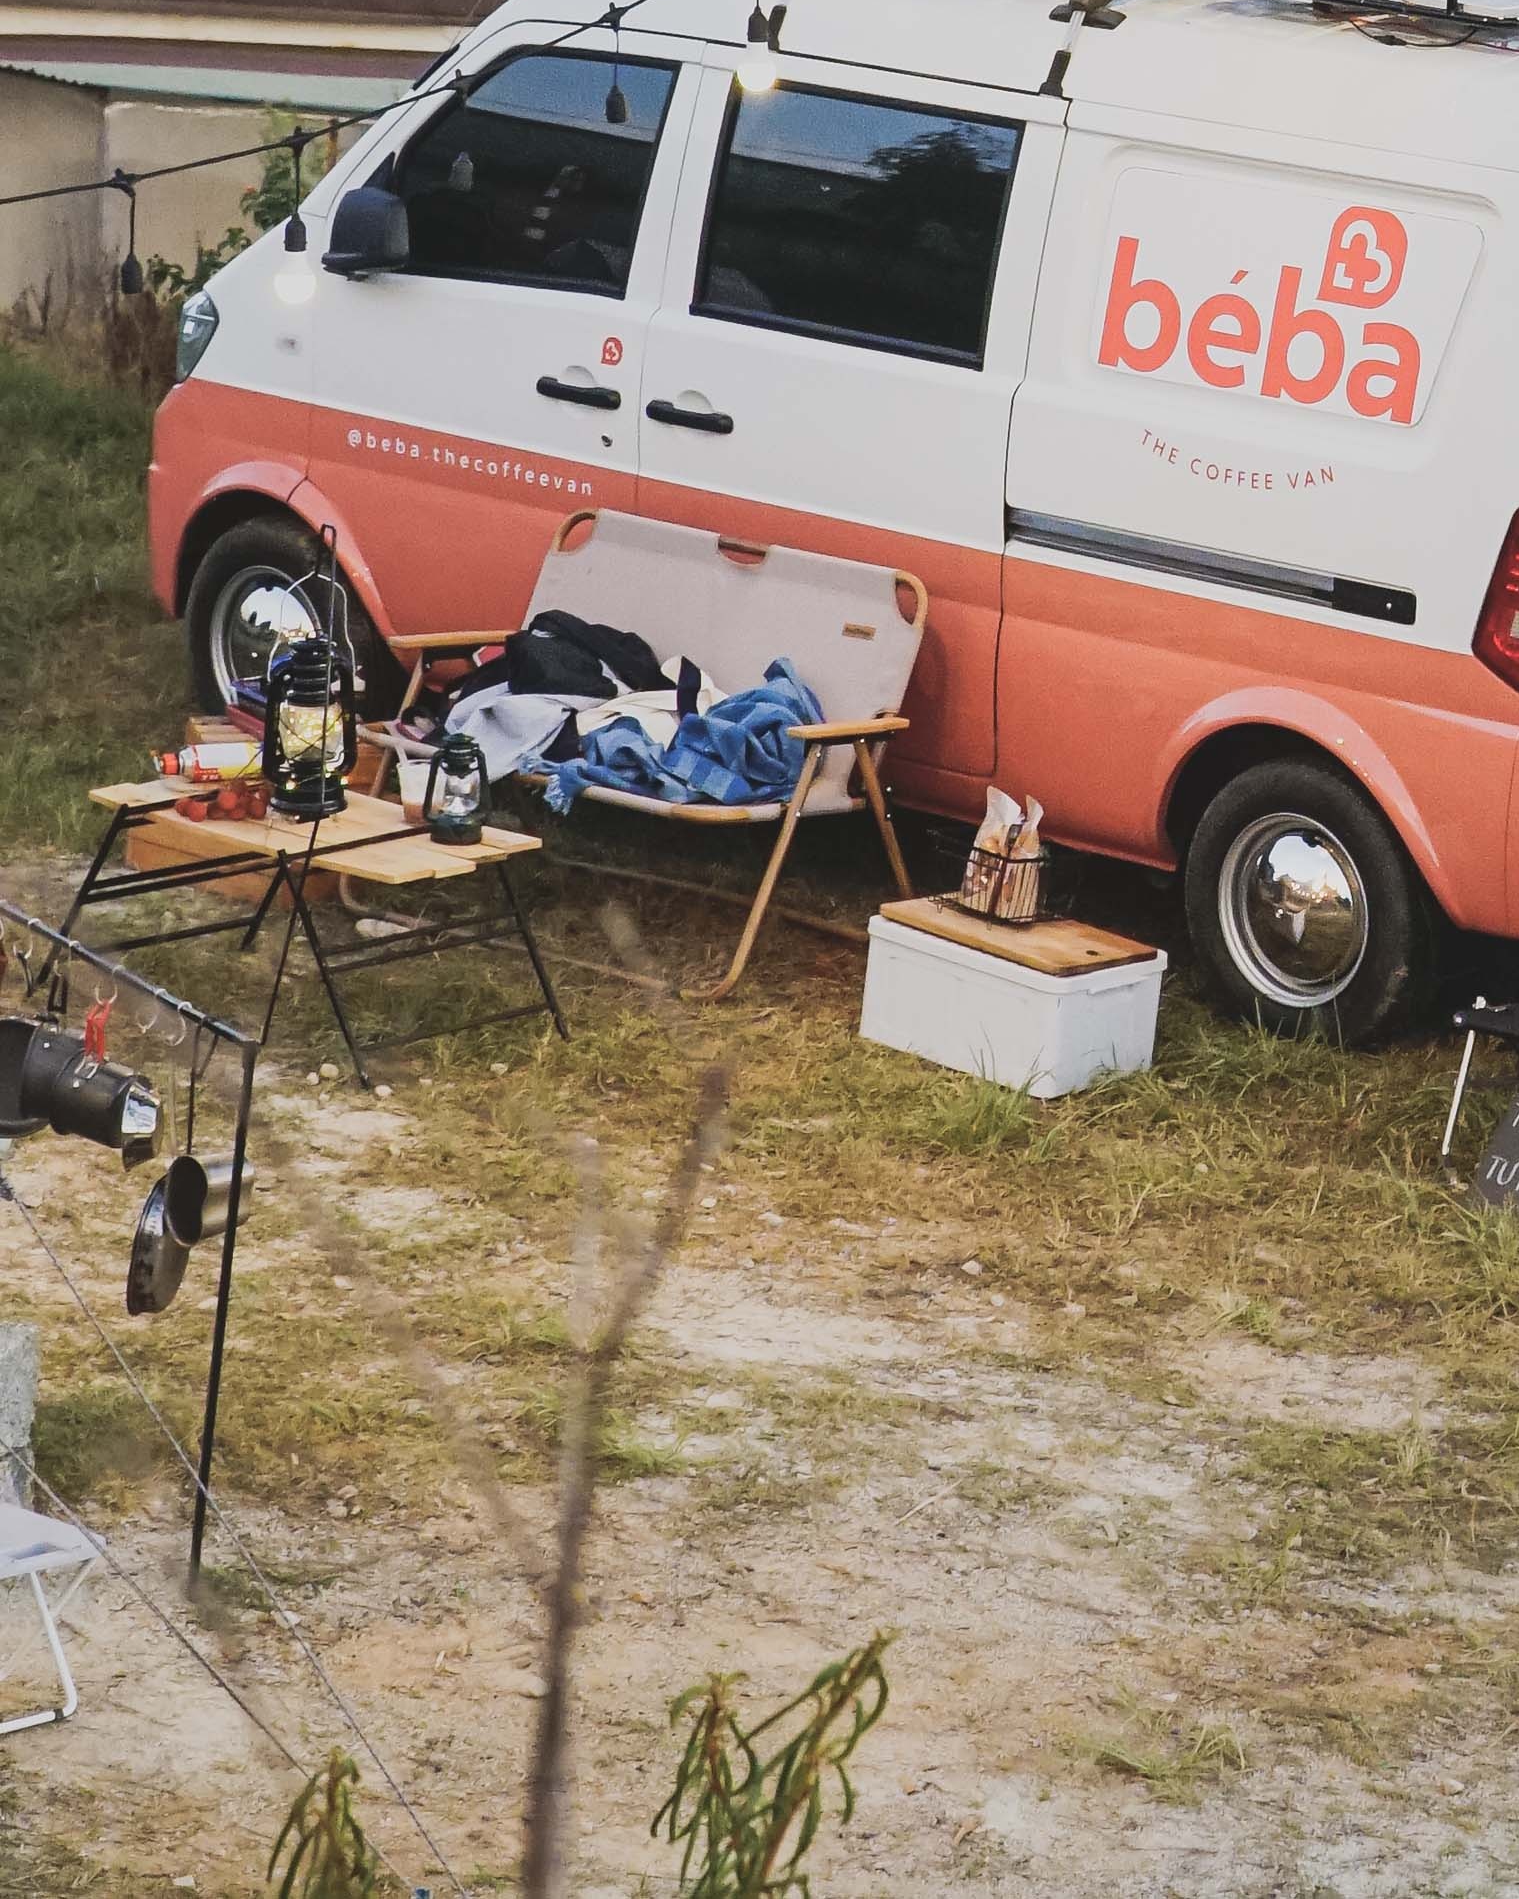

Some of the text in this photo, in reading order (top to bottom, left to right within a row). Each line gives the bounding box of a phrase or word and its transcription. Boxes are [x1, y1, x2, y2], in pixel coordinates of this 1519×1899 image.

[1097, 236, 1421, 424] béba
[347, 429, 593, 495] @beba.thecoffeevan
[1140, 428, 1334, 490] THE COFFEE VAN
